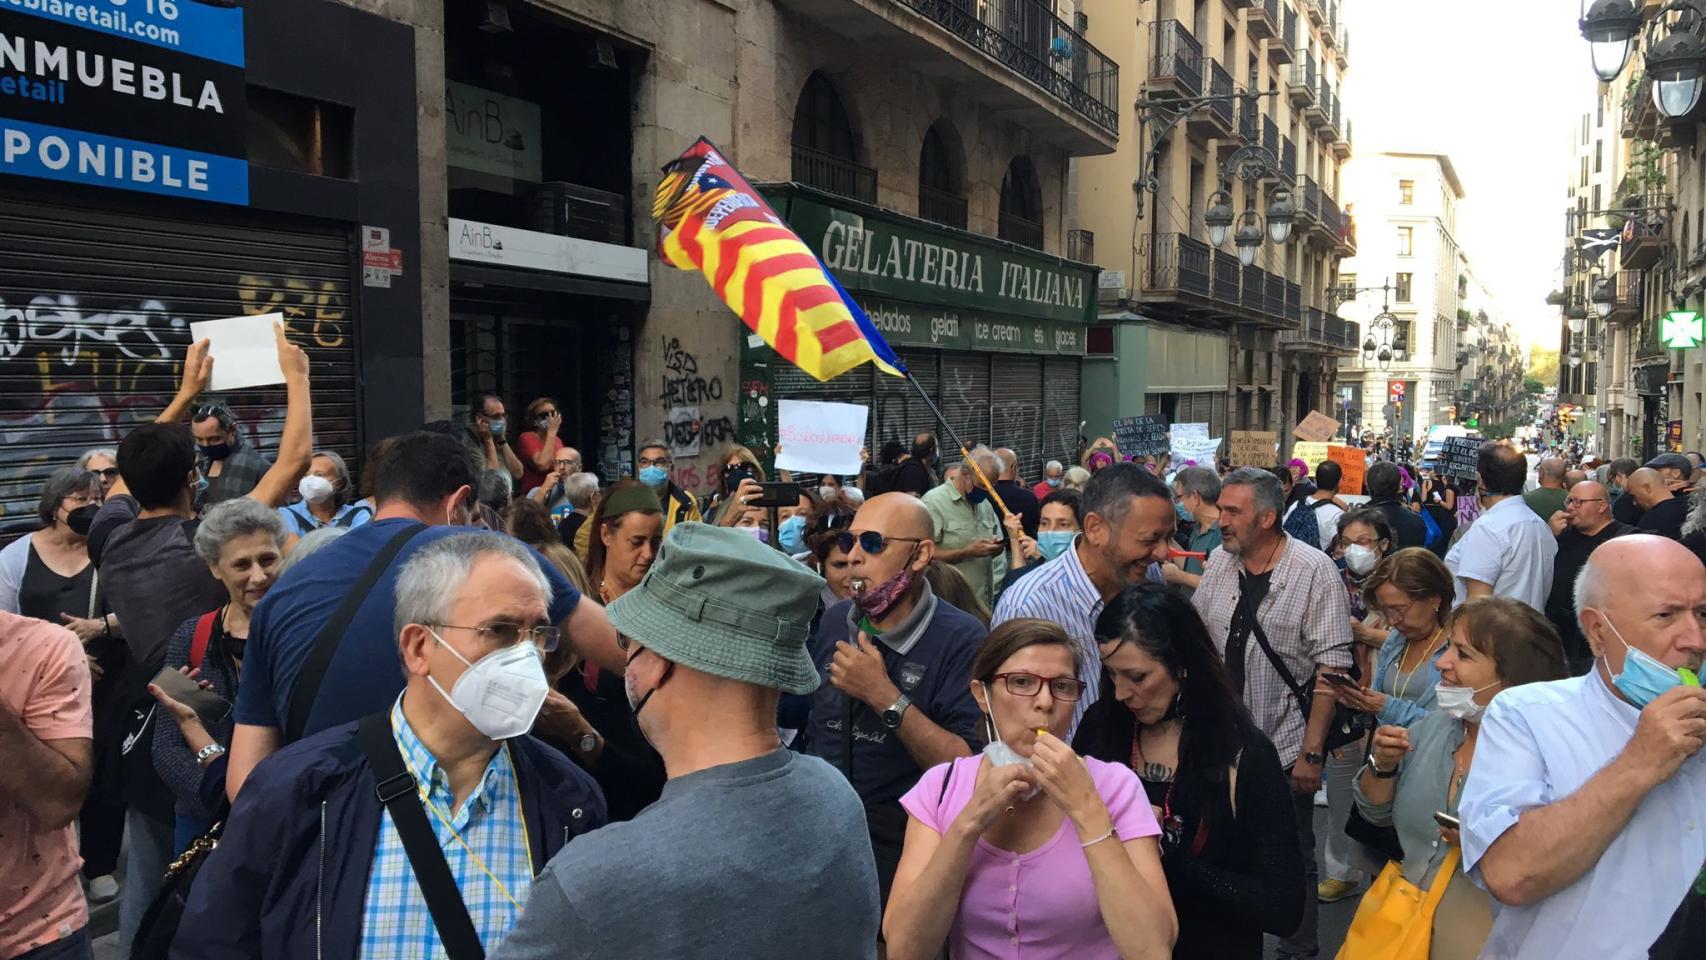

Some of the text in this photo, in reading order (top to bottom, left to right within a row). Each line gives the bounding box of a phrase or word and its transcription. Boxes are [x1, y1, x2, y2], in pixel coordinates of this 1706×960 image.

[4, 128, 209, 191] PONIBLE
[821, 219, 1084, 309] GELATERIA ITALIANA
[863, 301, 912, 334] helados
[931, 312, 960, 343] gelati
[974, 317, 989, 339] ice
[992, 323, 1022, 343] cream
[1034, 325, 1045, 344] eis
